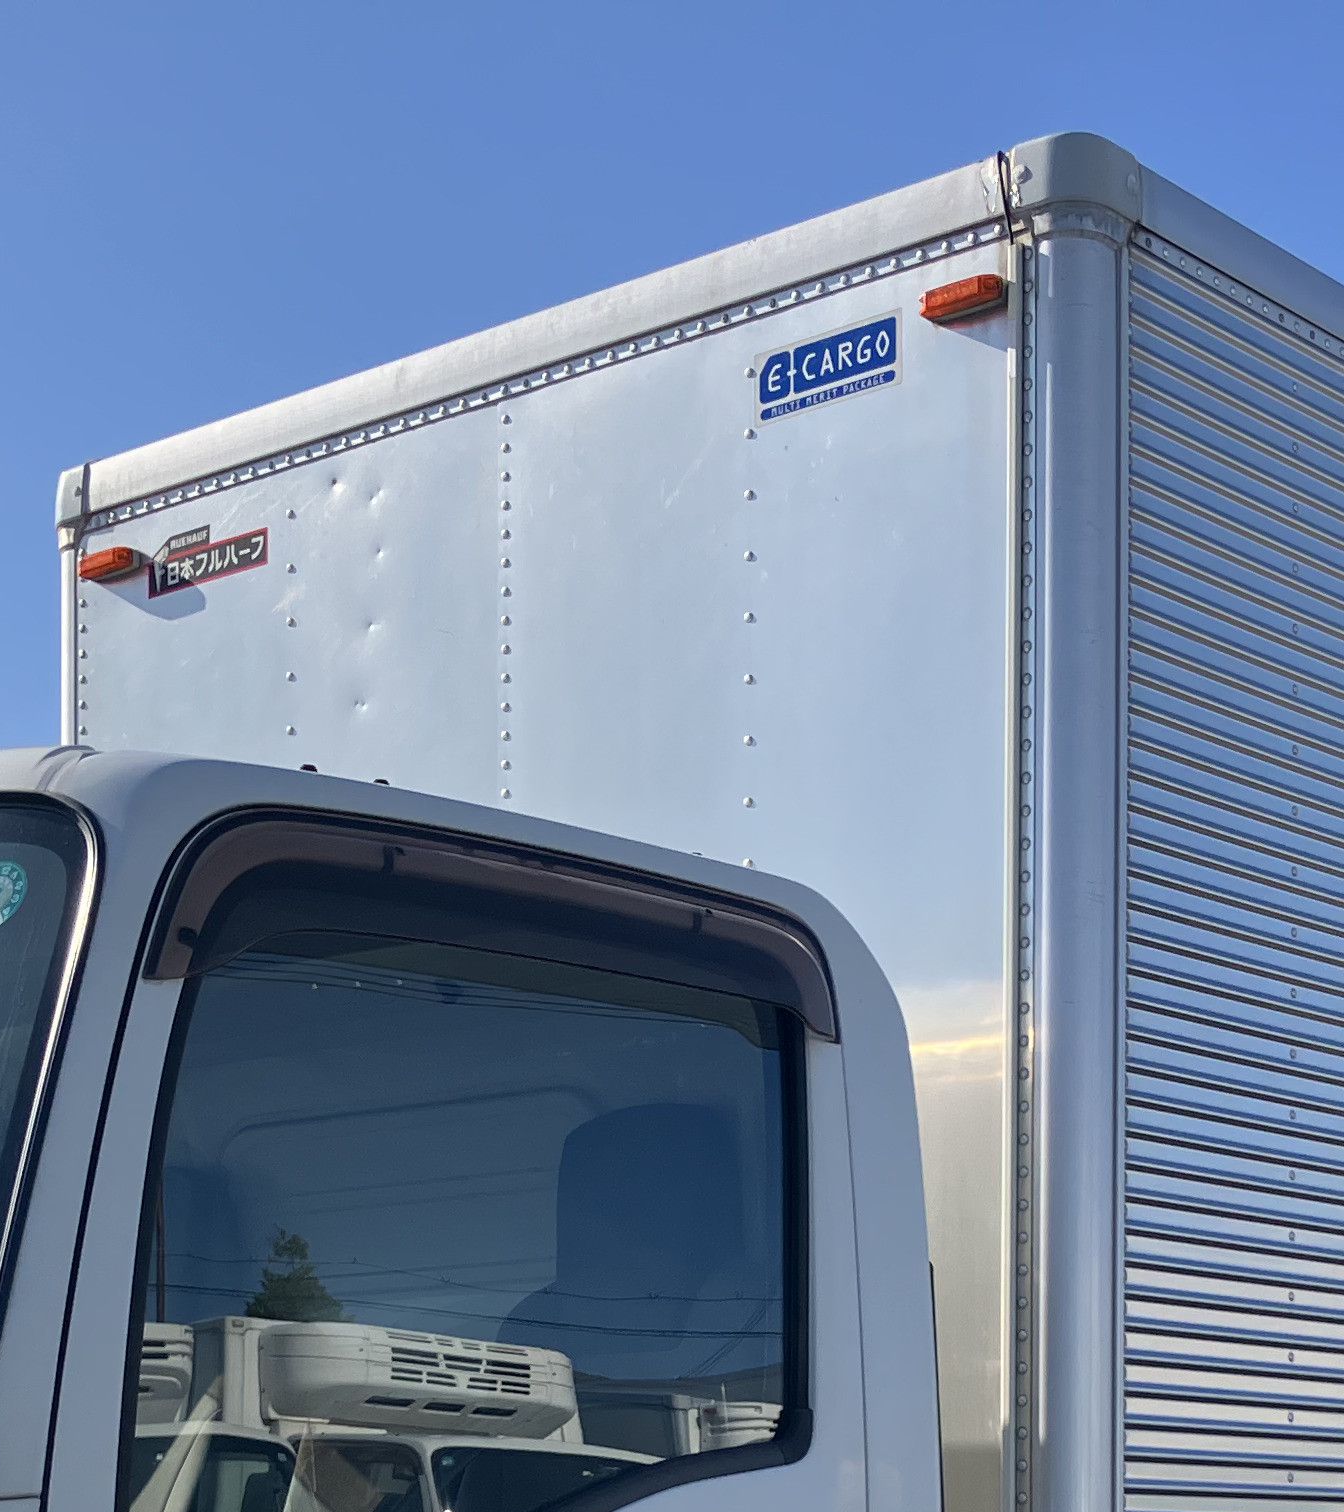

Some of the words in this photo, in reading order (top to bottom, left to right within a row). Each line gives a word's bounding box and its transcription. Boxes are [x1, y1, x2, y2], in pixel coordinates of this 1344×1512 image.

[770, 400, 802, 417] MULTI
[806, 388, 838, 406] MERIT
[843, 374, 885, 395] PACKAGE
[167, 535, 265, 587] 日本フルハーフ
